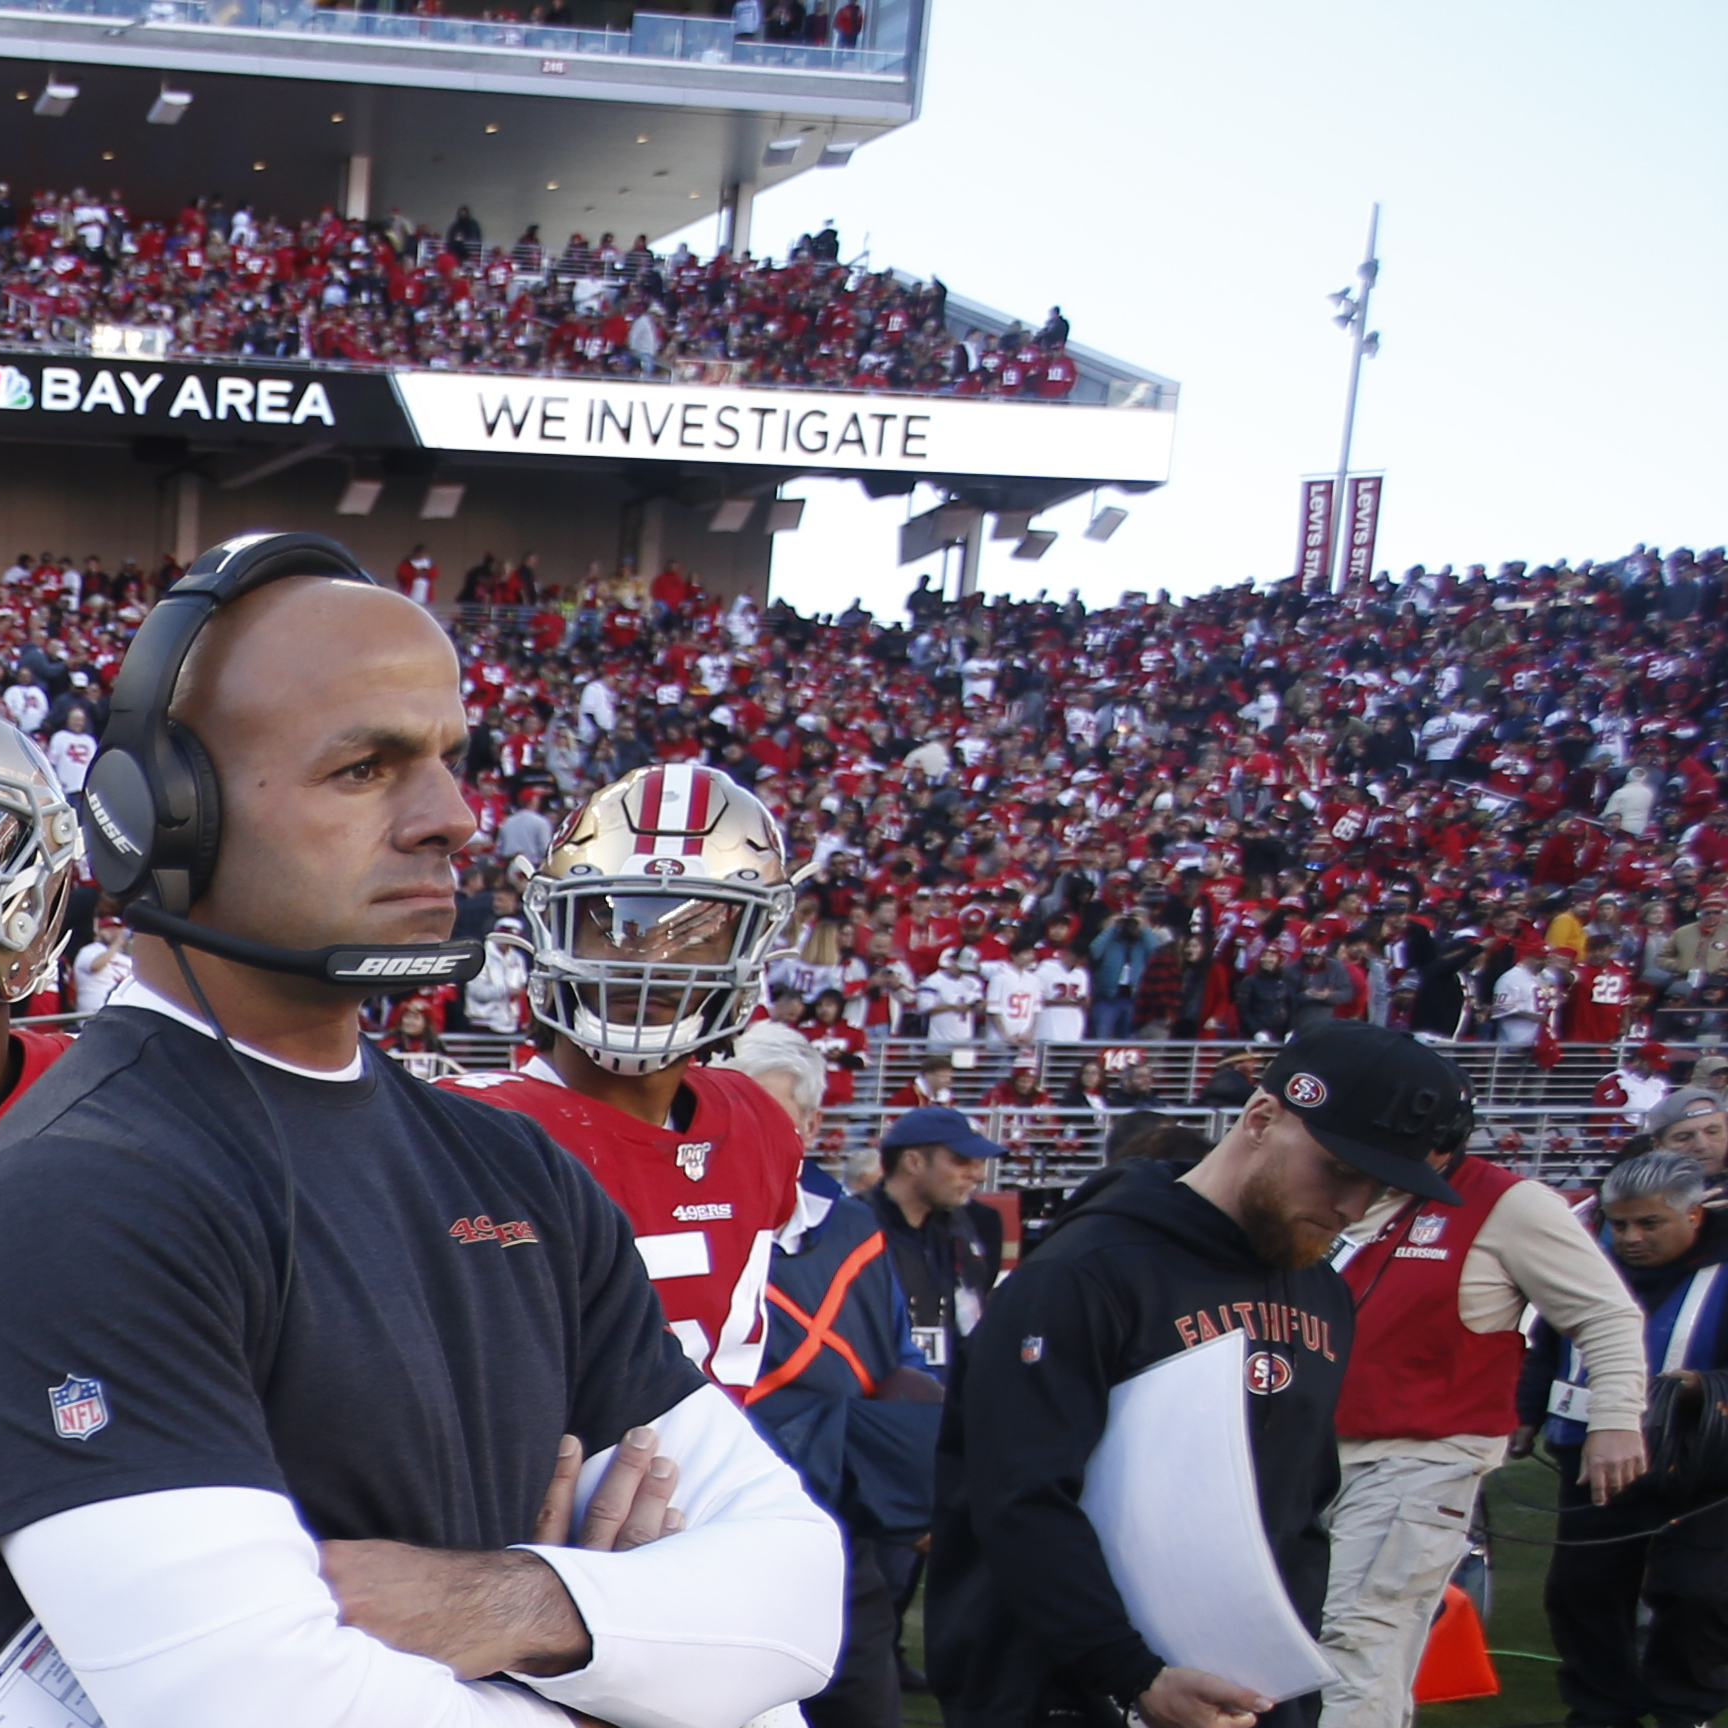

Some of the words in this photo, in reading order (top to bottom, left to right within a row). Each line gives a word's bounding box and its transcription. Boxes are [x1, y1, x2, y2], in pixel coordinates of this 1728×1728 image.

[40, 364, 163, 418] BAY
[168, 370, 334, 428] AREA
[477, 391, 568, 443] WE
[584, 400, 931, 462] INVESTIGATE
[86, 789, 142, 857] BOSE
[1331, 817, 1361, 842] 85
[344, 954, 466, 977] BOSE
[1591, 975, 1621, 1004] 22
[1103, 1049, 1138, 1071] 143
[672, 1203, 733, 1222] 49ERS
[1395, 1246, 1448, 1261] ELEVISION
[1175, 1299, 1336, 1363] FAITHFUL
[59, 1401, 101, 1433] NFL
